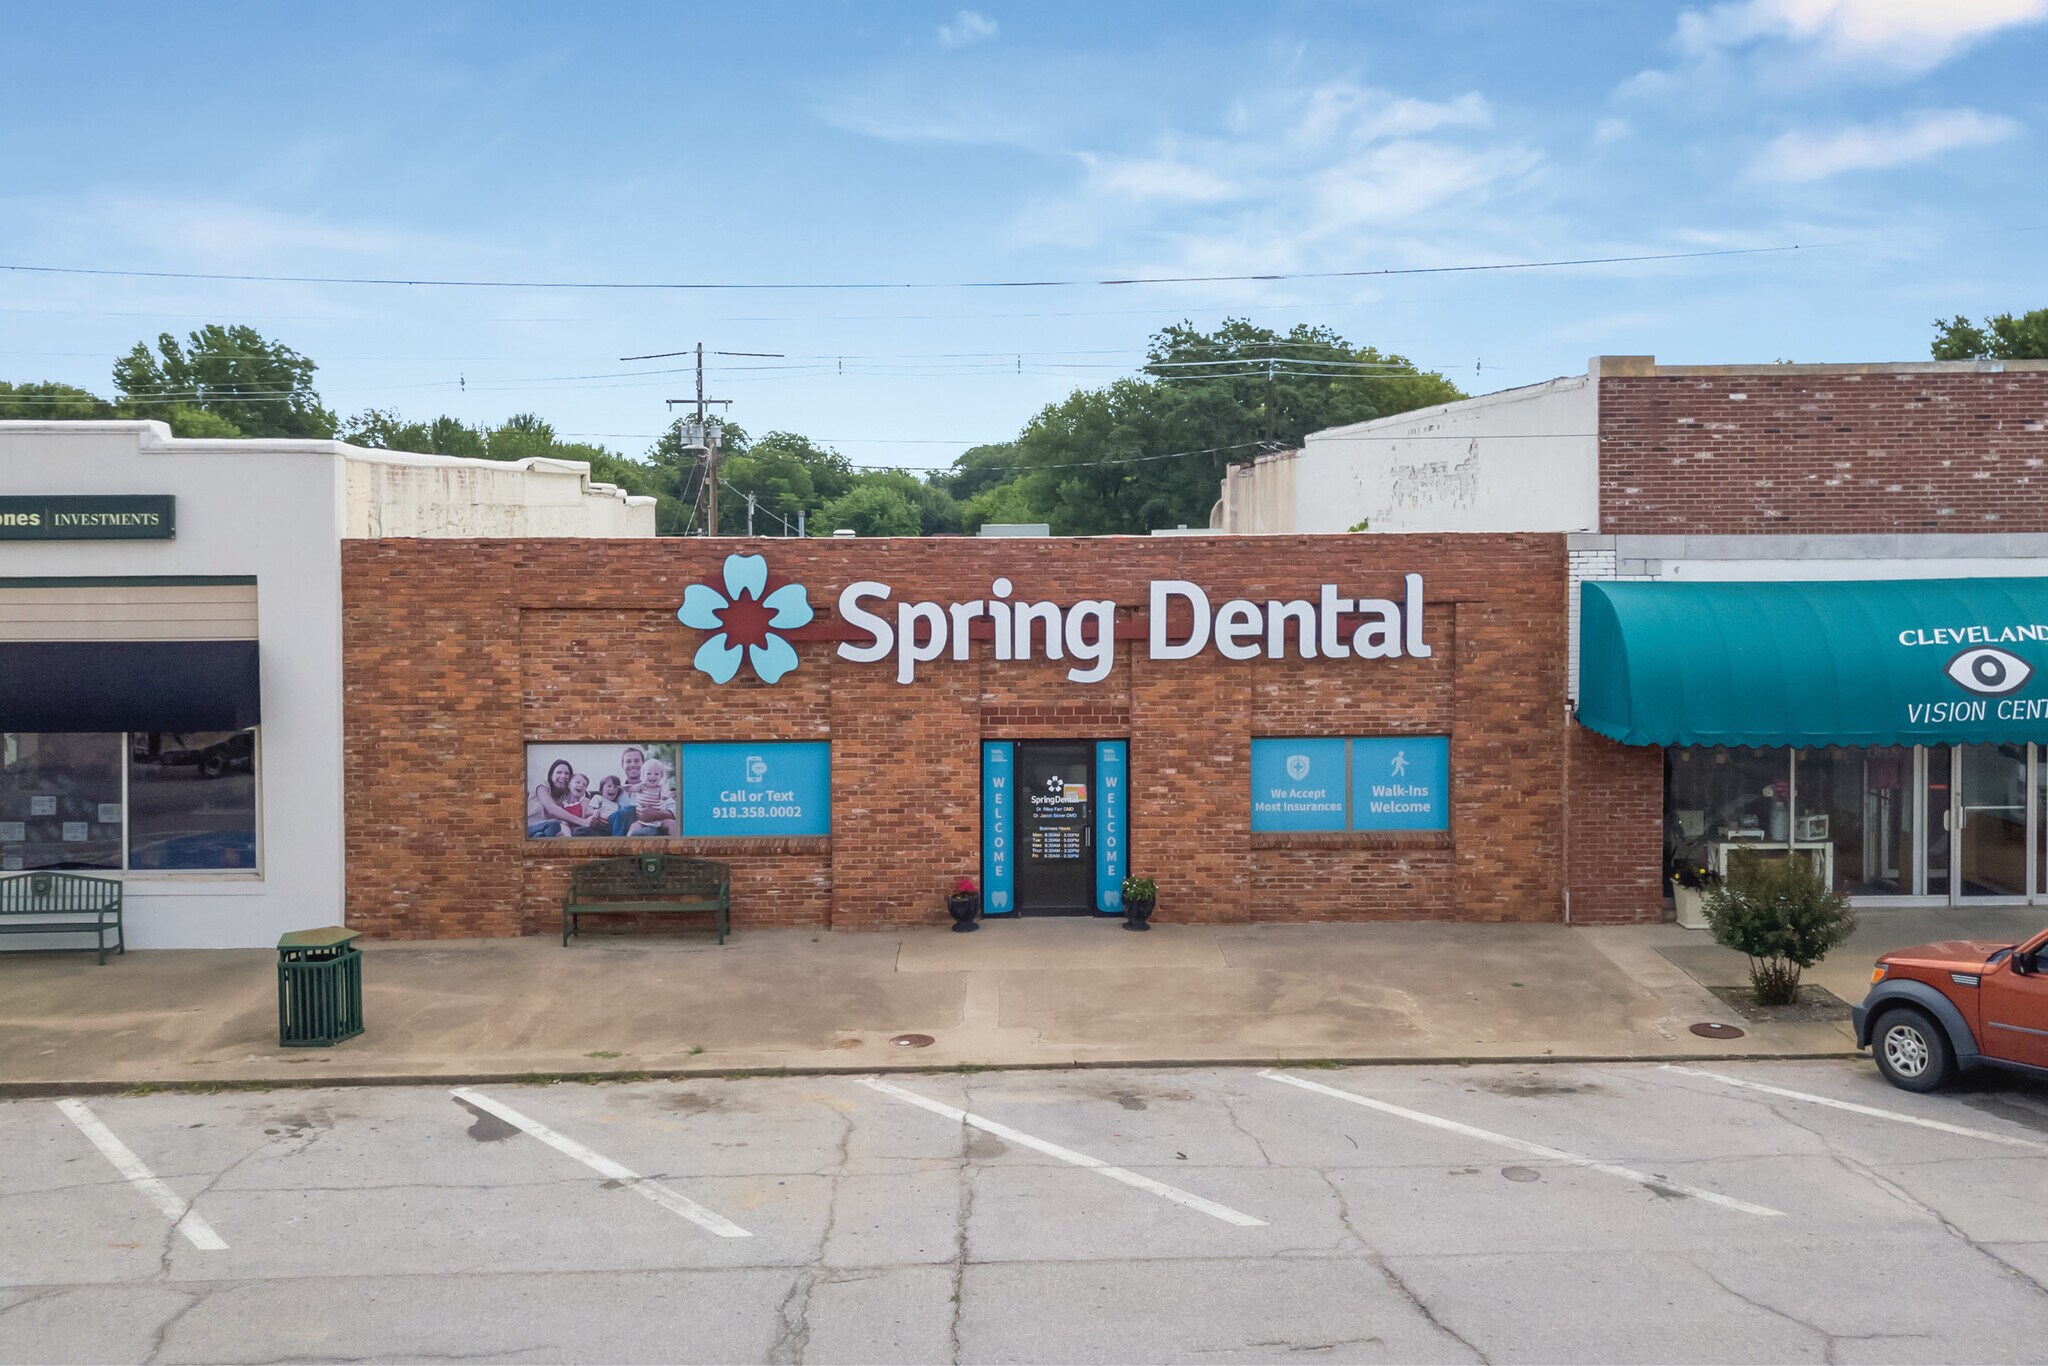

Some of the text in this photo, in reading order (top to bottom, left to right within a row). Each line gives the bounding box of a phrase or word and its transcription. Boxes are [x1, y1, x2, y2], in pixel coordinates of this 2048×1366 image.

[0, 513, 41, 526] nes
[54, 513, 159, 526] INVESTMENTS
[836, 572, 1432, 685] Spring Dental
[1898, 624, 2048, 646] CLEVELAND
[1908, 701, 1986, 723] VISION
[720, 790, 794, 802] Call or Text
[1271, 789, 1326, 800] We Accept
[1372, 785, 1429, 797] Walk-Ins
[712, 806, 802, 819] 918.358.0002
[1255, 801, 1342, 812] Most Insurances
[1370, 800, 1431, 813] Welcome
[993, 777, 1005, 876] WELCOME
[1105, 777, 1117, 876] WELCOME
